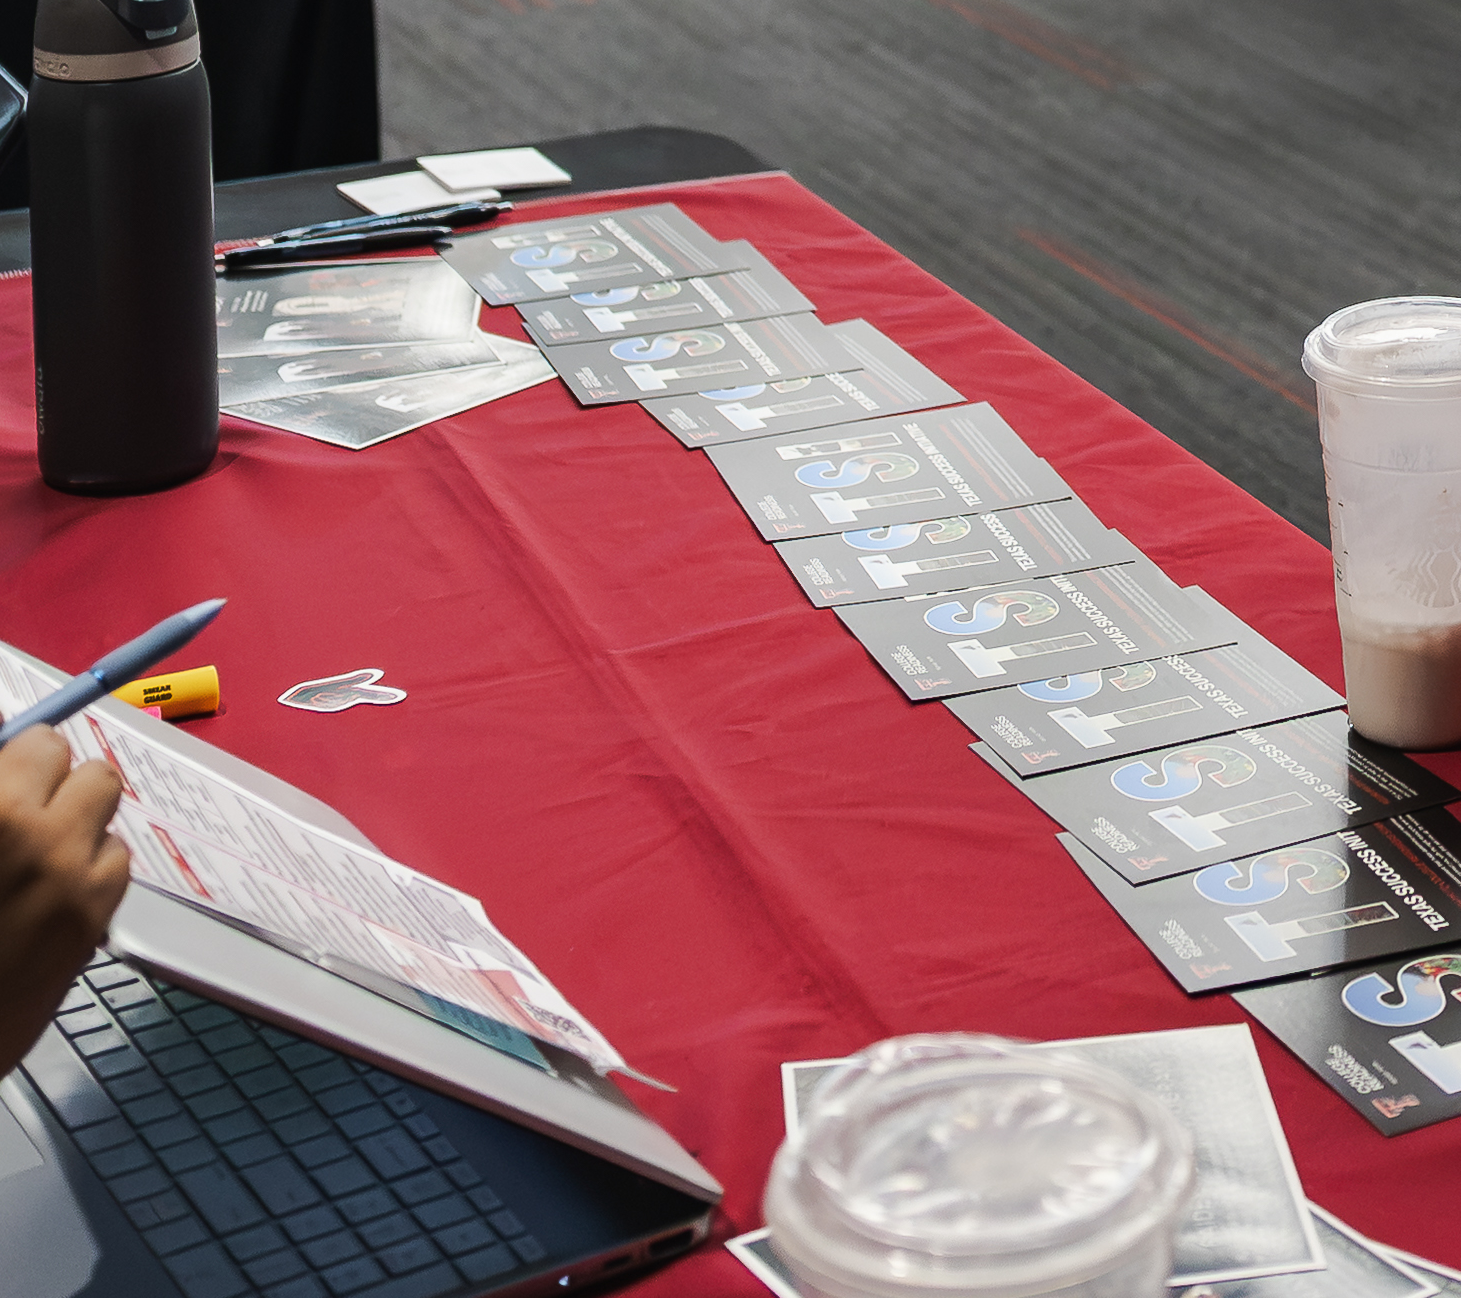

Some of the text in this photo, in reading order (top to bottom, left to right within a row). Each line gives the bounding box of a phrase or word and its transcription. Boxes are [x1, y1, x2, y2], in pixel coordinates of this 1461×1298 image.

[609, 329, 749, 392] TS
[775, 432, 946, 524] TSI
[842, 516, 1000, 590] TS
[923, 590, 1098, 679] TS
[1065, 590, 1110, 629] SUCCESS
[1102, 624, 1140, 655] TEXAS
[1017, 661, 1203, 749] TS
[1162, 654, 1250, 719] TEXAS SUCCESS
[1258, 743, 1322, 786] SUCCESS
[1110, 745, 1313, 852] TS
[1314, 782, 1363, 815] TEXAS
[1356, 847, 1409, 897] SUCCESS
[1193, 847, 1399, 962] TS
[1403, 893, 1450, 932] TEXAS
